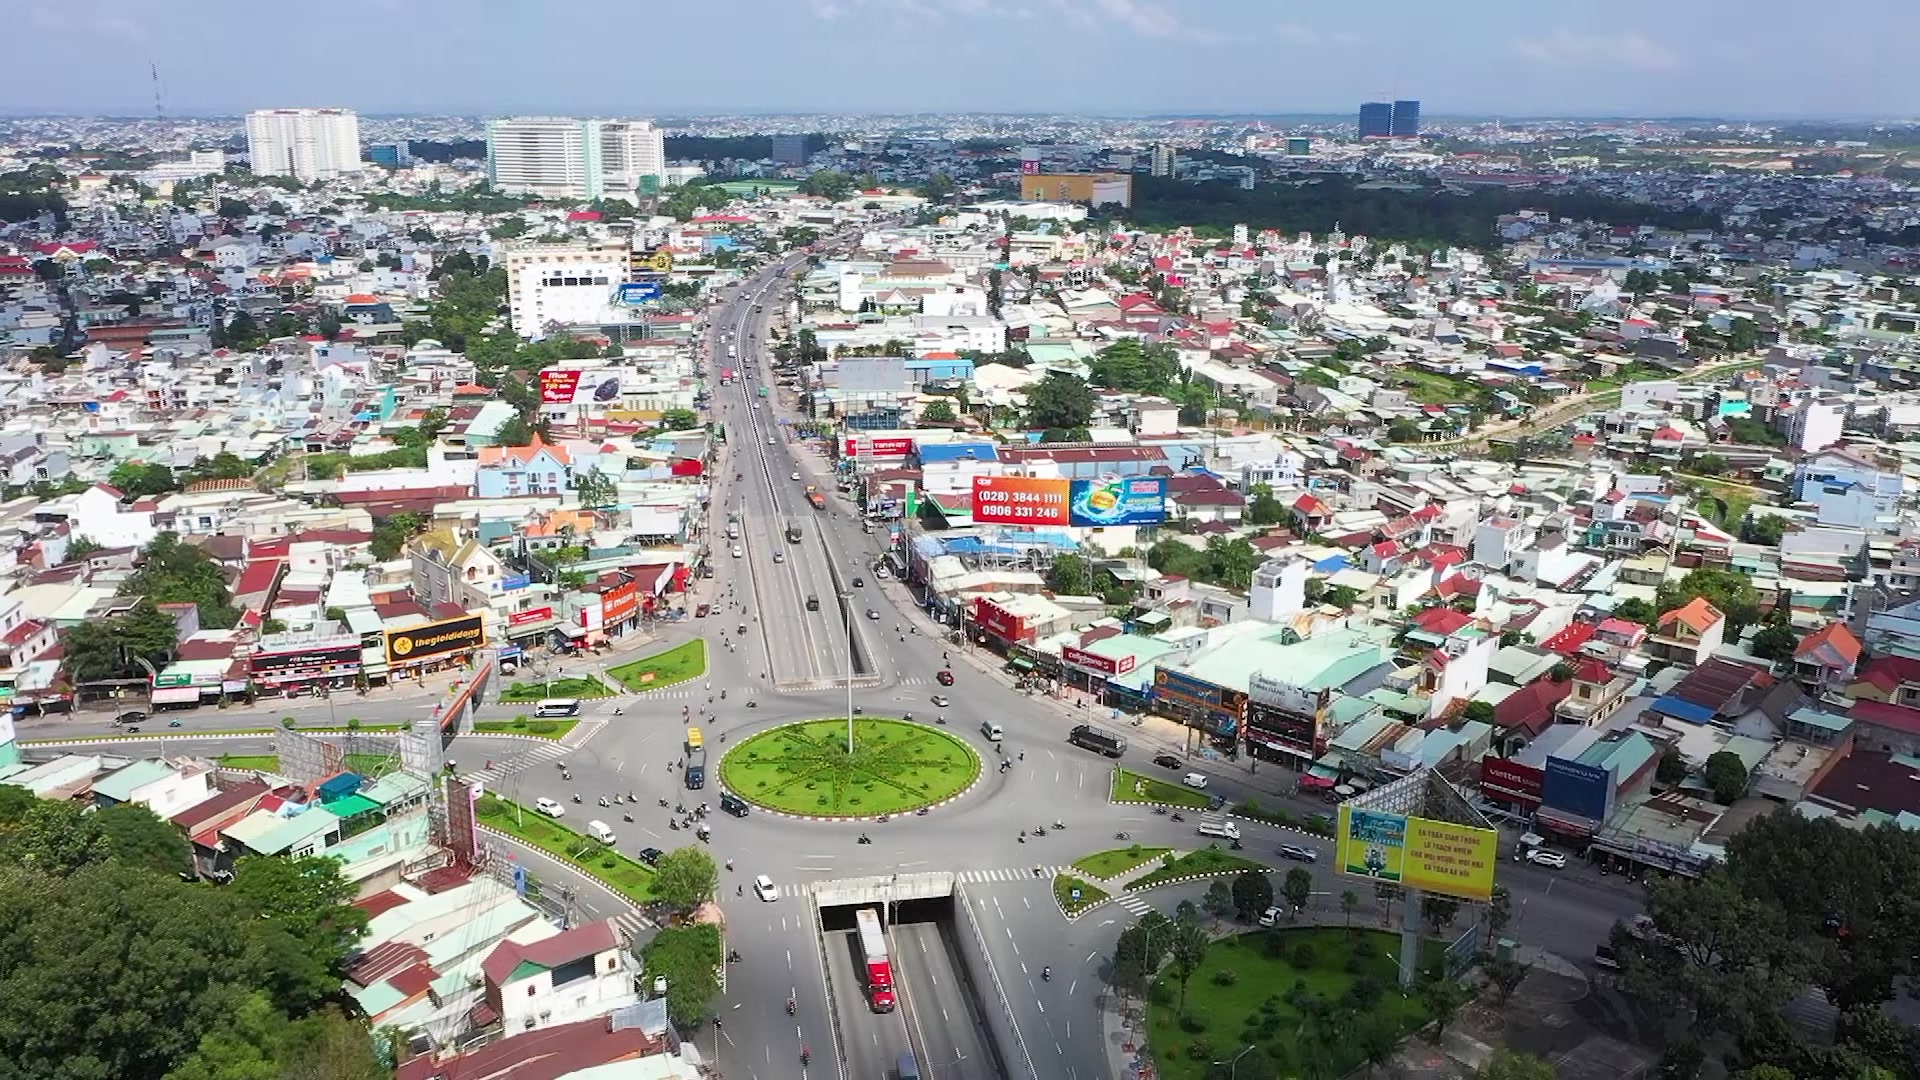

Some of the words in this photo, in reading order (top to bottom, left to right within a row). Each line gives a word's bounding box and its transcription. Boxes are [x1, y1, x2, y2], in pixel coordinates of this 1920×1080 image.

[978, 490, 1009, 503] (028)
[1012, 492, 1040, 503] 3844
[1044, 493, 1062, 503] 1111
[982, 505, 1012, 516] 0906
[1015, 506, 1033, 517] 331
[1036, 507, 1058, 518] 246
[414, 628, 480, 648] thegioididong
[1490, 768, 1522, 783] viettel
